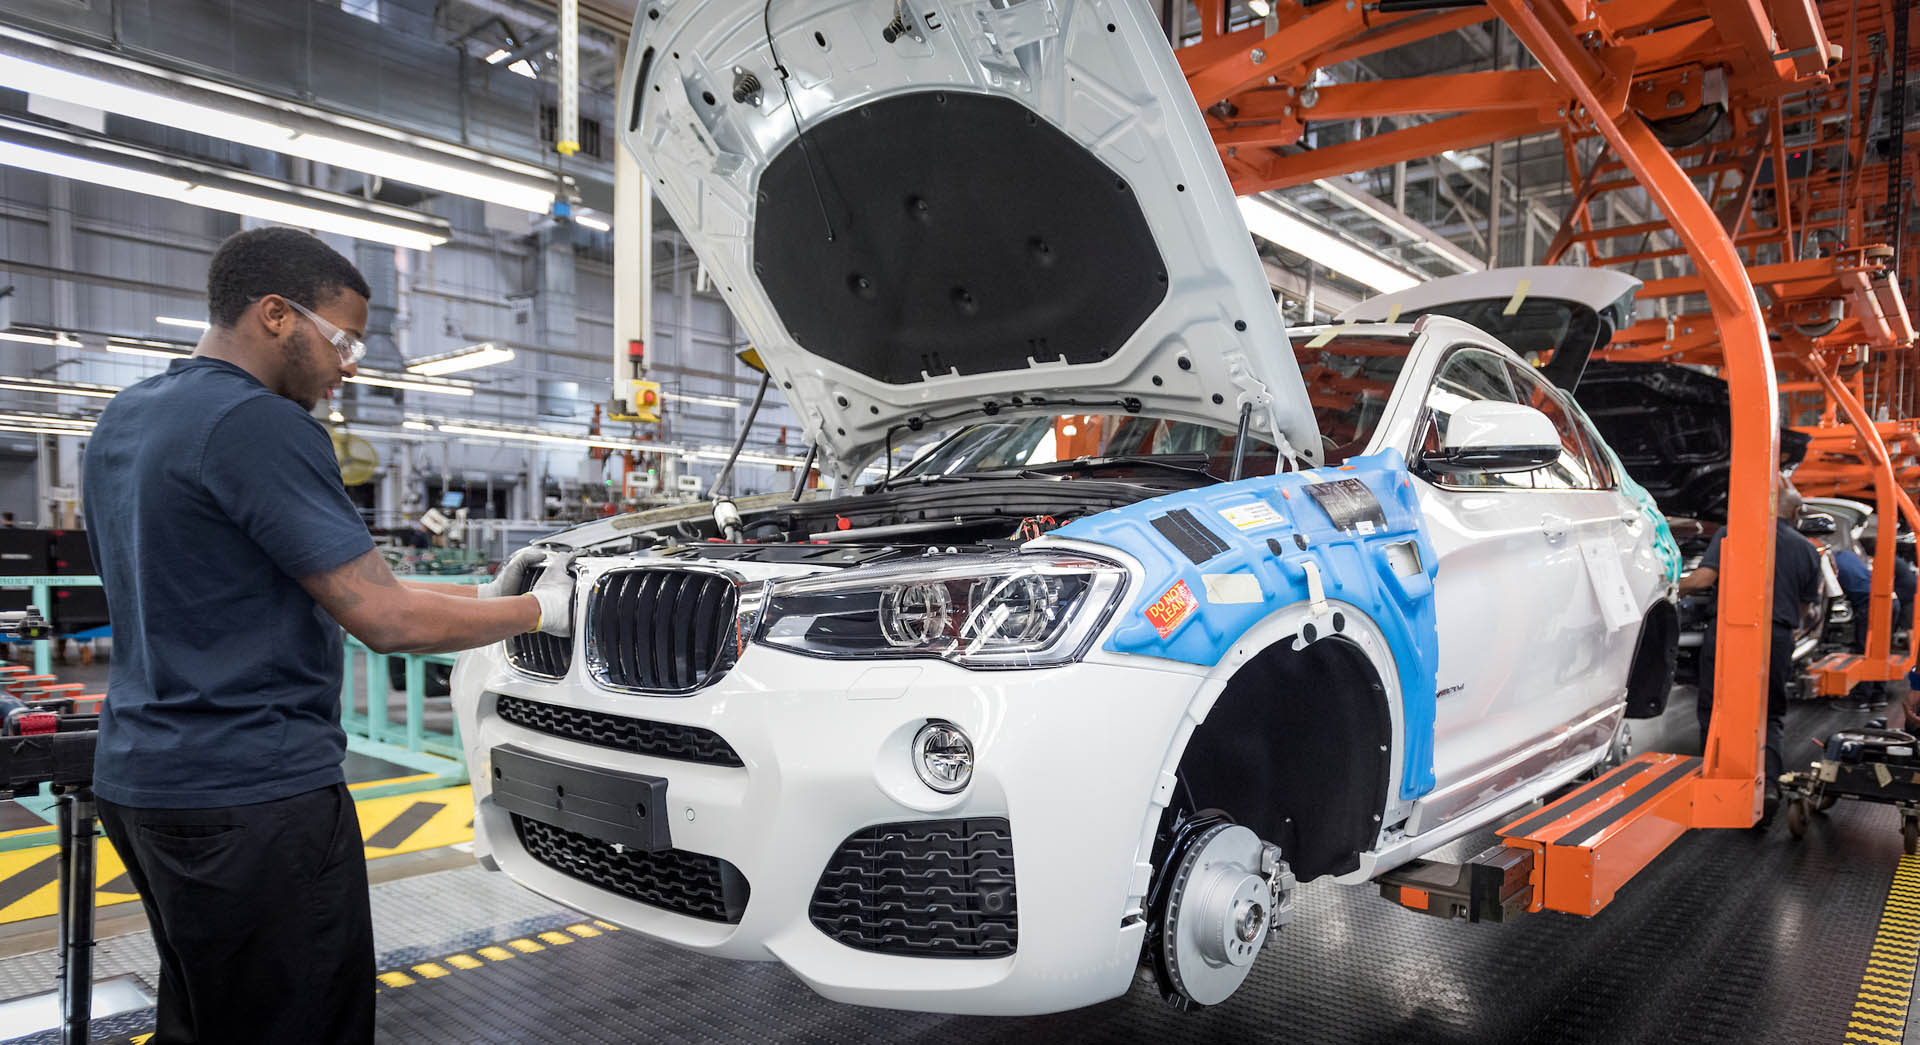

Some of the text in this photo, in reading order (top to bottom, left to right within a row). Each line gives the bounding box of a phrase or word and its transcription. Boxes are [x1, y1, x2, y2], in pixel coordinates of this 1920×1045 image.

[1149, 602, 1166, 618] DO
[1163, 583, 1183, 605] NOT
[1160, 597, 1186, 623] LEAN
